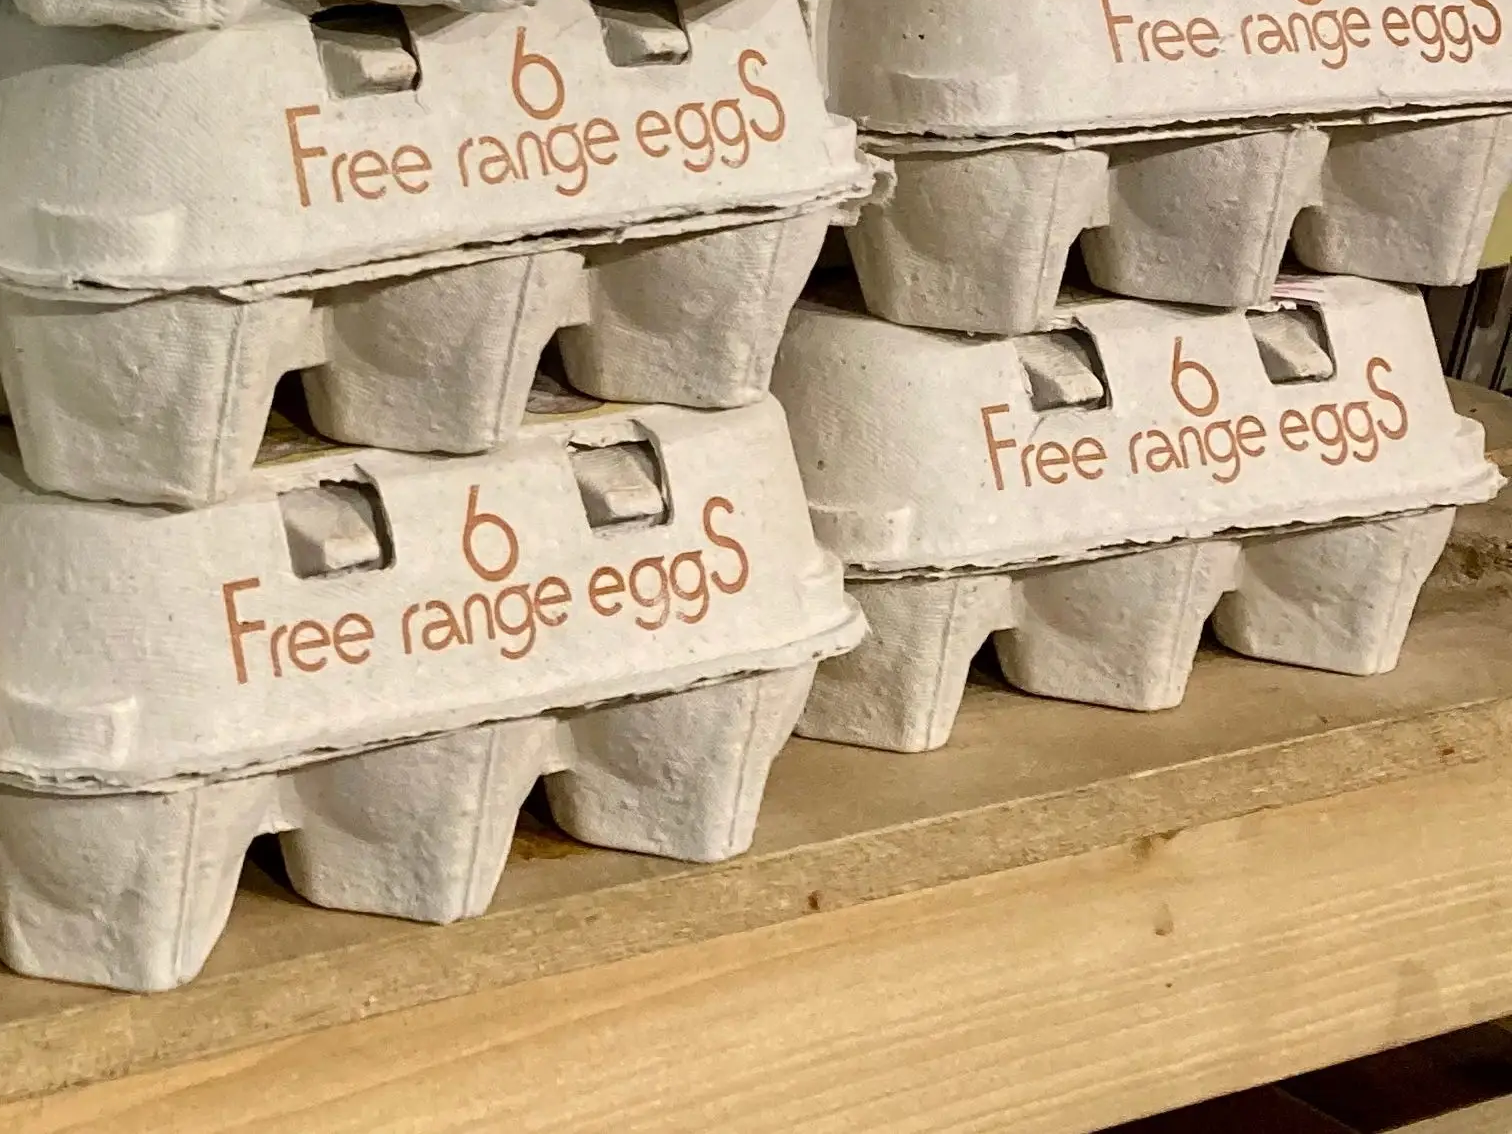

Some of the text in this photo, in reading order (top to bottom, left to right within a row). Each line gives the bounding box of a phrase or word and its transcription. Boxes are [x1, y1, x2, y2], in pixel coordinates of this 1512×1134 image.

[511, 26, 565, 120] 6
[1240, 6, 1372, 70] range
[287, 48, 788, 208] Free range eggS
[982, 357, 1409, 491] Free range eggS
[1171, 338, 1219, 417] 6
[462, 485, 518, 582] 6
[222, 496, 751, 684] Free range eggS
